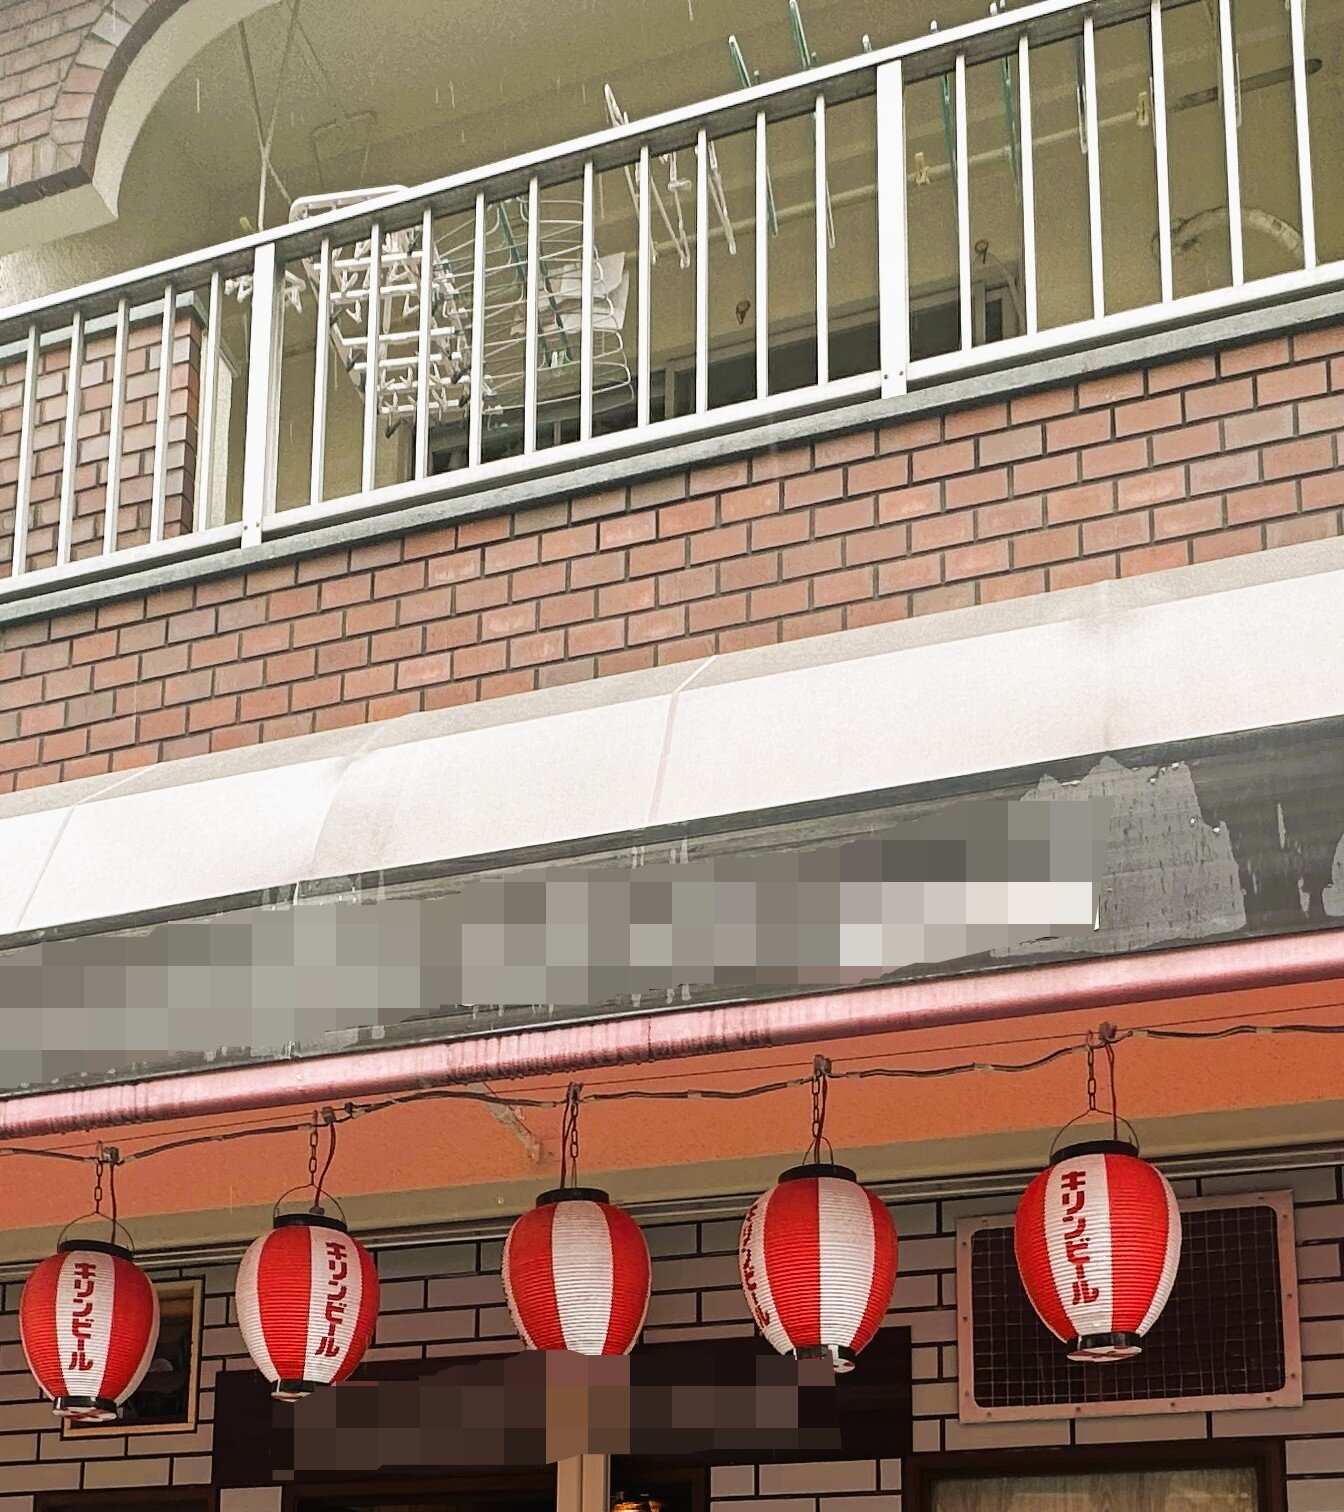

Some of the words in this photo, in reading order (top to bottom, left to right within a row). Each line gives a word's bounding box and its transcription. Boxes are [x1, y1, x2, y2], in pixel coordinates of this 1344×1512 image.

[1060, 1170, 1100, 1306] キリンビール
[68, 1262, 98, 1371] キリンビール
[315, 1241, 349, 1357] キリンビール
